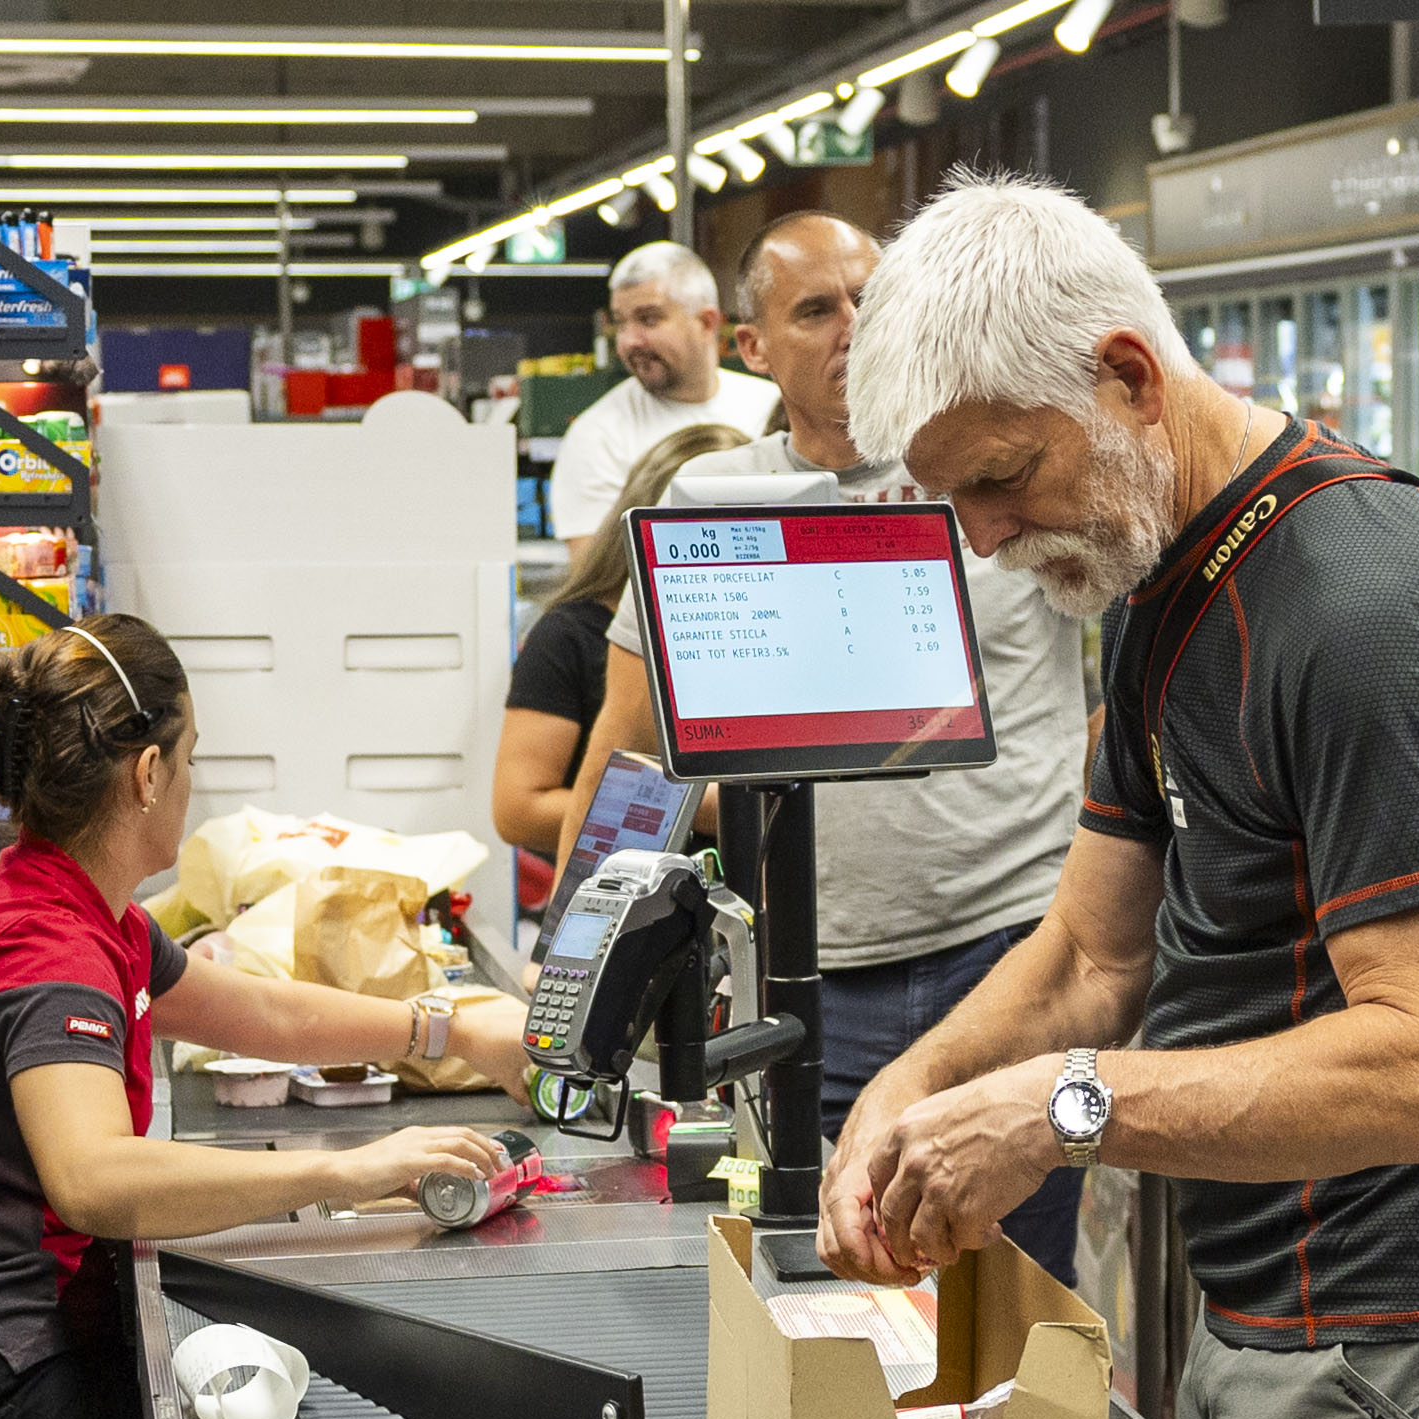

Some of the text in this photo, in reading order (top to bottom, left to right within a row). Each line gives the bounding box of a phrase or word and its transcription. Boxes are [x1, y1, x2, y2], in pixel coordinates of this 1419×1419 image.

[701, 527, 716, 540] kg
[1202, 493, 1278, 582] Canon
[669, 543, 720, 561] 0,000
[663, 568, 926, 584] PARIZER PORCFELIAT C 5.05
[666, 586, 930, 603] MILKERIA 150G C 7.59
[670, 604, 933, 622] ALEXANDRION 200ML B 19.29
[672, 623, 936, 641] GARANTIE STICLA A 0.50
[676, 641, 940, 660] BONI TOT KEFIR3.5% C 2.69
[684, 724, 731, 742] SUMA:
